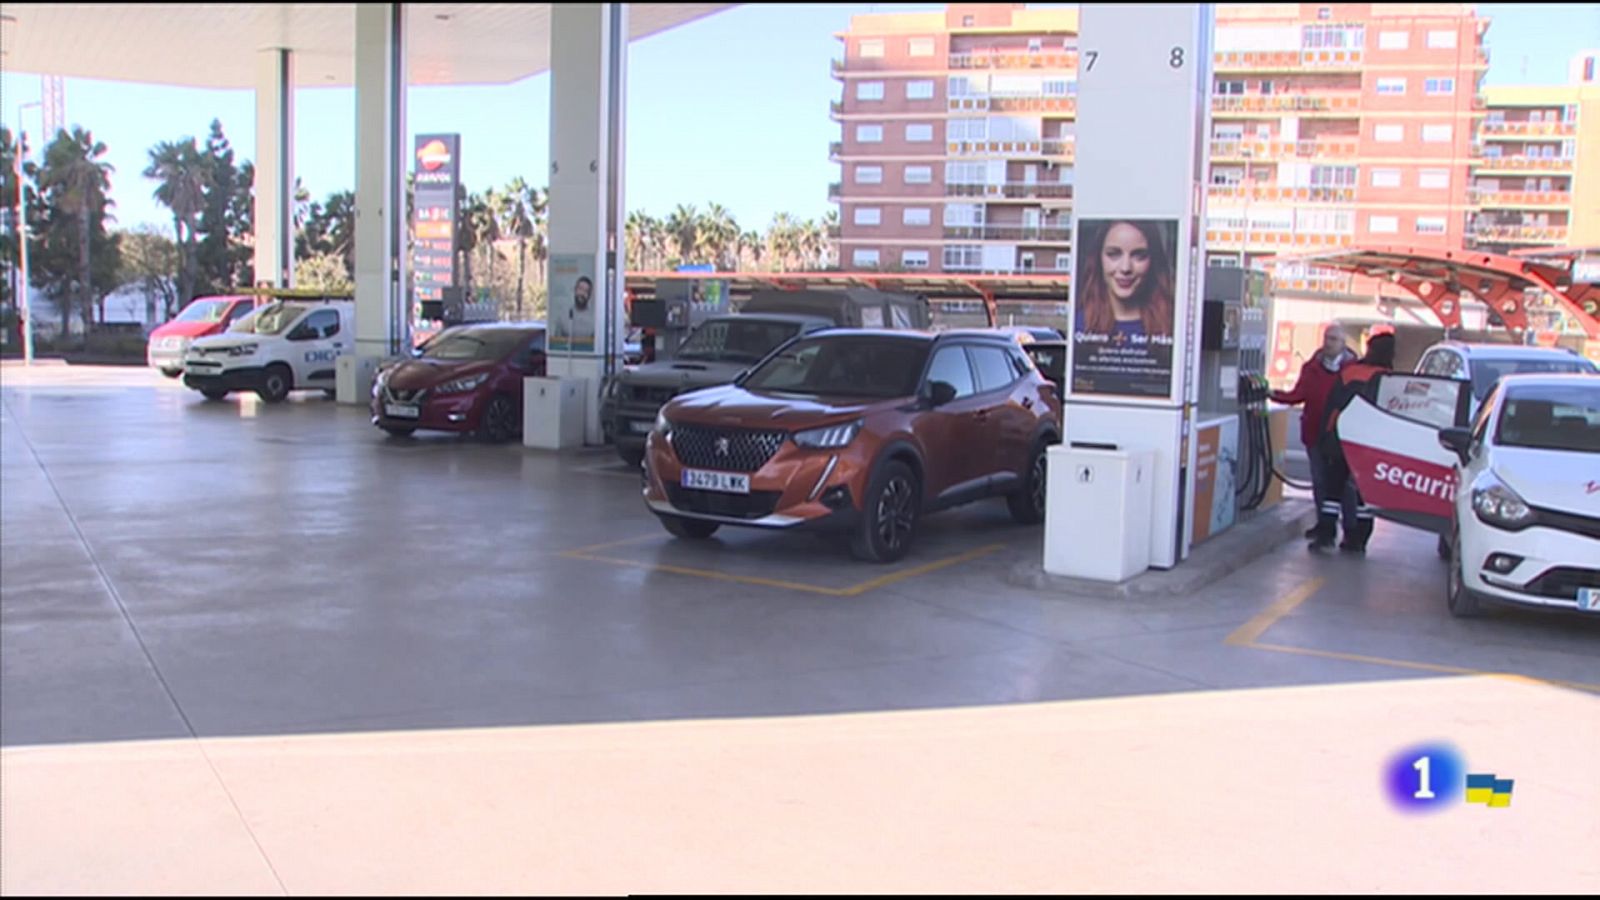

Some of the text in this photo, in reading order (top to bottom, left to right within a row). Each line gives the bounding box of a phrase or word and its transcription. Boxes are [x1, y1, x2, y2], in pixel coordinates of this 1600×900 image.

[1085, 51, 1098, 72] 7
[1169, 46, 1184, 69] 8
[551, 160, 559, 174] 5
[590, 160, 598, 173] 6
[1075, 332, 1173, 345] Quiero Ser Más
